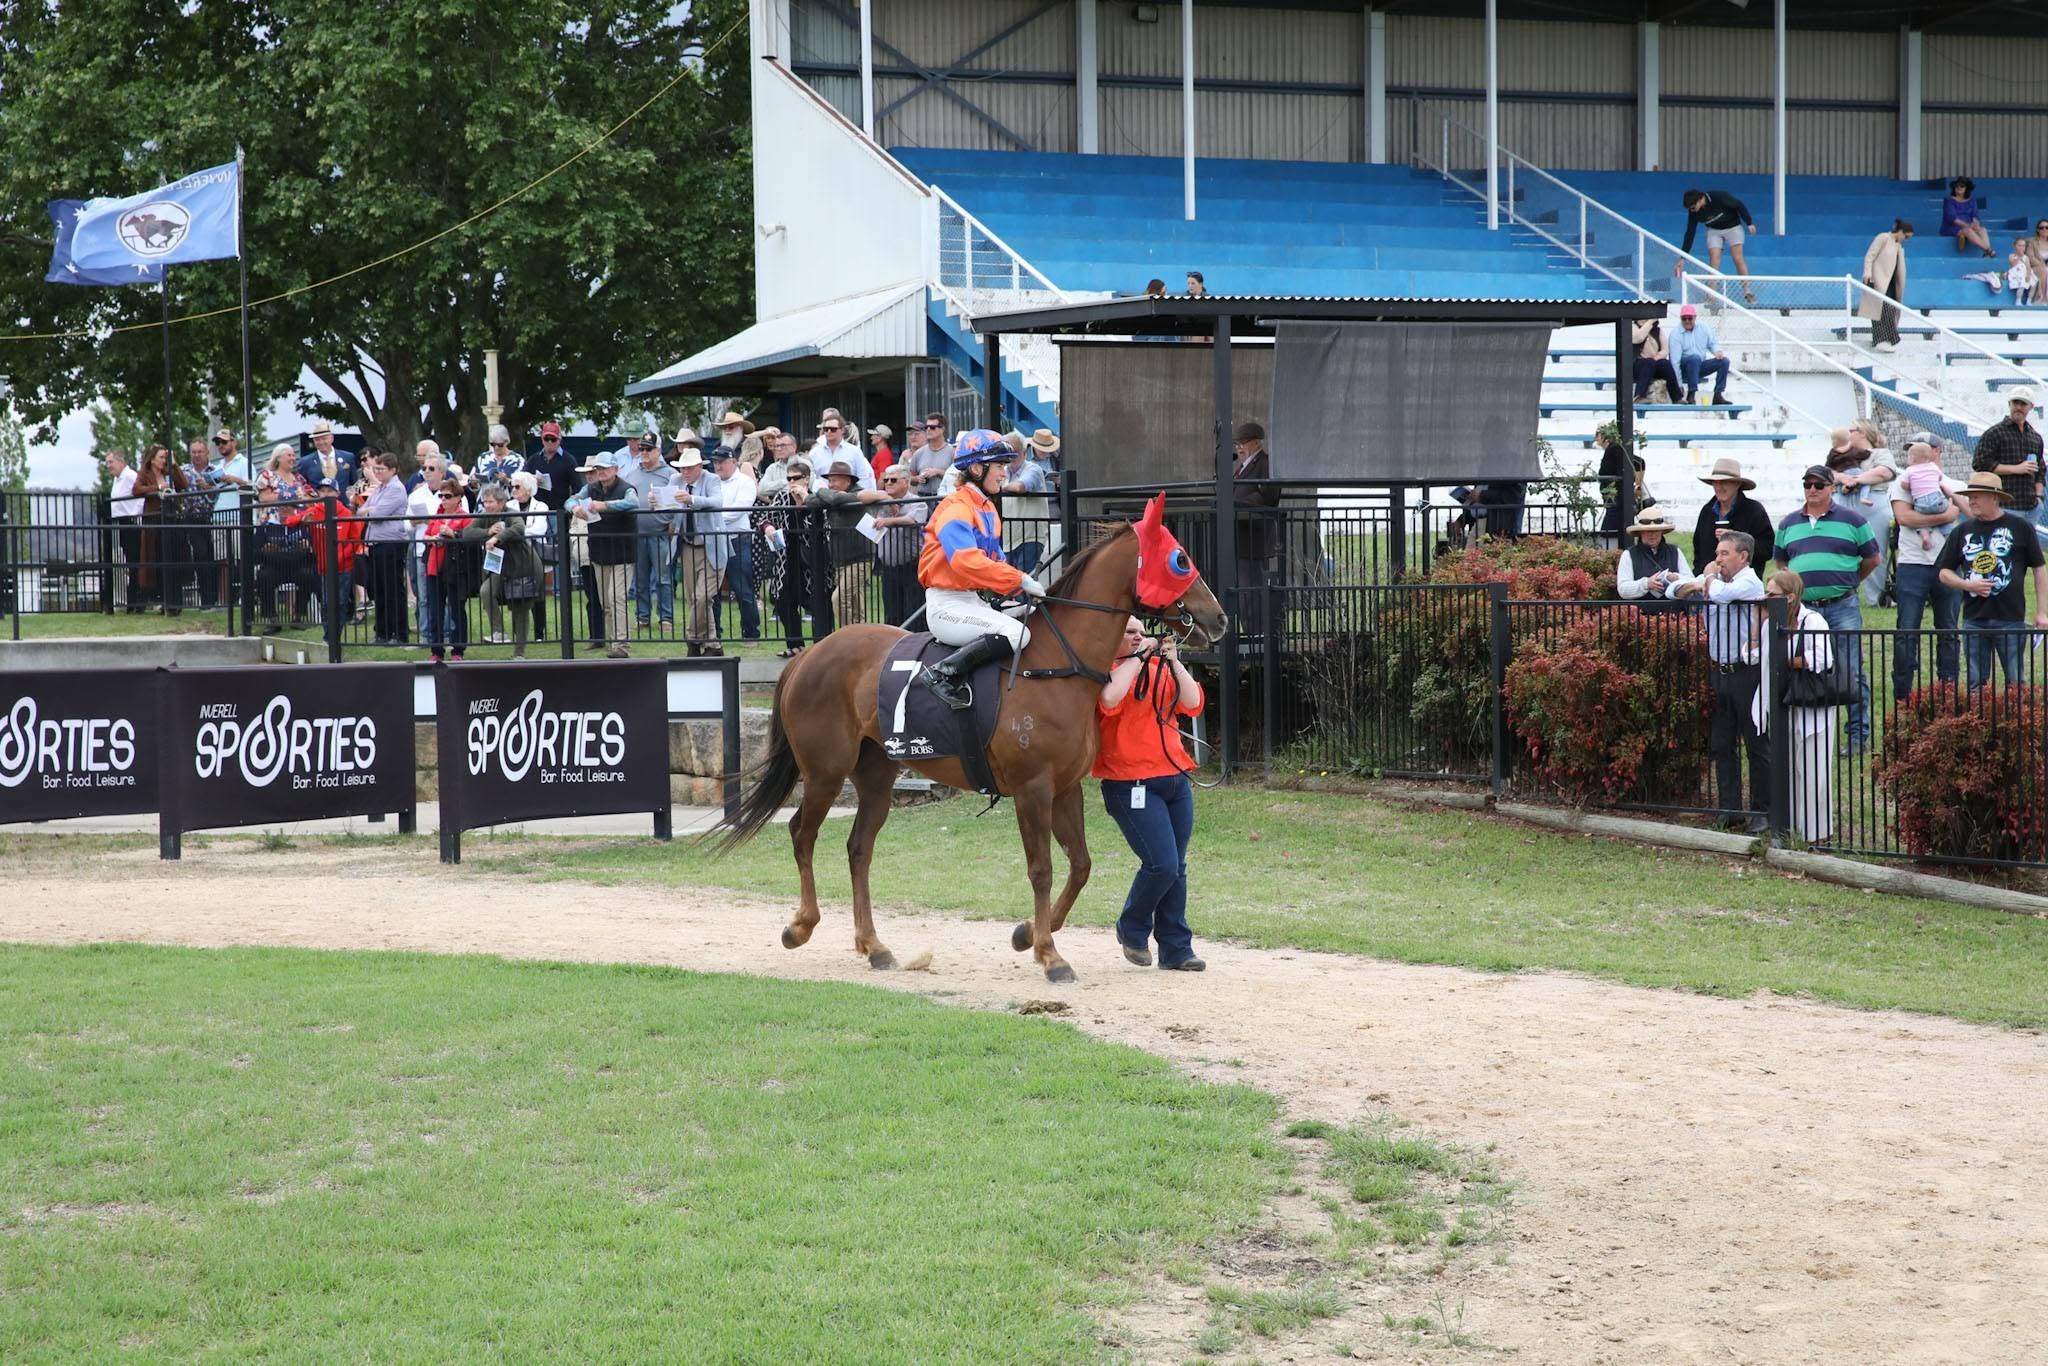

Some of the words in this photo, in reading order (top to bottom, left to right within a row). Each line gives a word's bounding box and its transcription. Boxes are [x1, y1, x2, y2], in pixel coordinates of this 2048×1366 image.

[891, 660, 922, 733] 7
[200, 703, 238, 719] INVERELL
[468, 698, 500, 715] INVERELL
[195, 695, 376, 788] SPORTIES
[468, 688, 626, 782] SPORTIES
[910, 745, 935, 755] BOBS
[43, 774, 63, 789] Bar.
[66, 773, 92, 787] Food.
[96, 772, 137, 786] Leisure.
[292, 775, 313, 789] Bar.
[316, 773, 339, 788] Food.
[343, 772, 377, 786] Leisure.
[541, 770, 558, 783] Bar.
[561, 768, 584, 783] Food.
[588, 768, 626, 782] Leisure.
